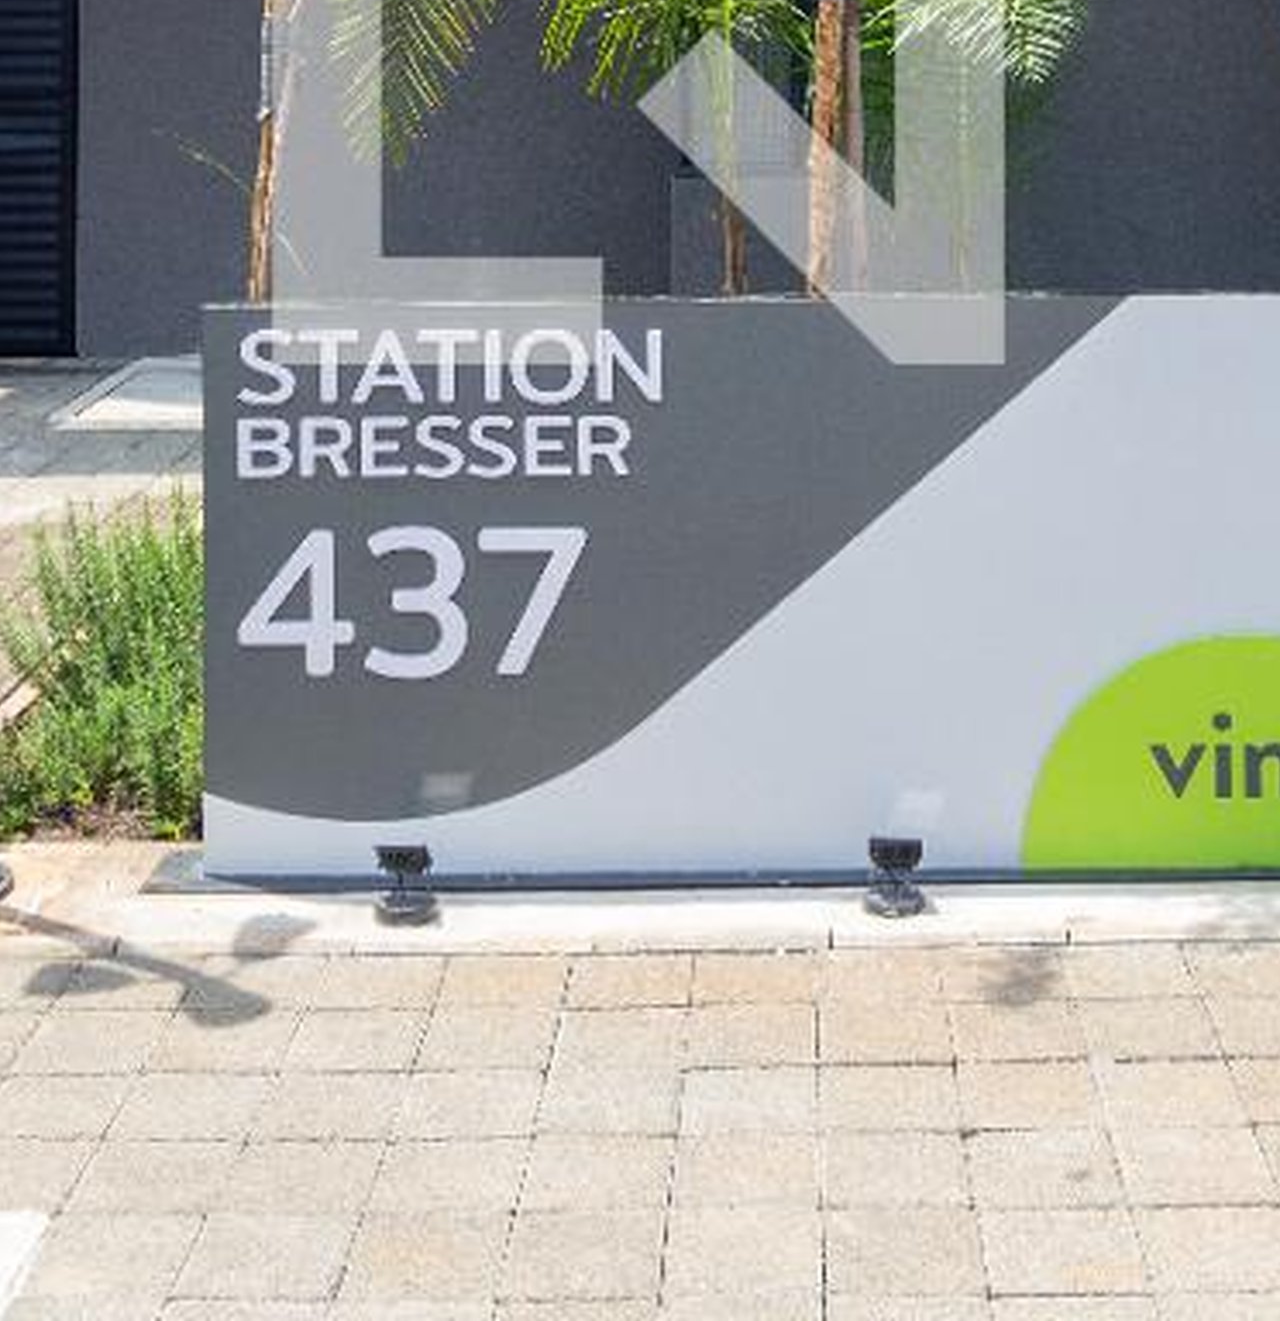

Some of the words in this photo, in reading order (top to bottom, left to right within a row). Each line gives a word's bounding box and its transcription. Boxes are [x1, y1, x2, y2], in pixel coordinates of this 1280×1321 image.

[237, 328, 663, 405] STATION
[237, 415, 632, 477] BRESSER
[237, 526, 588, 678] 437
